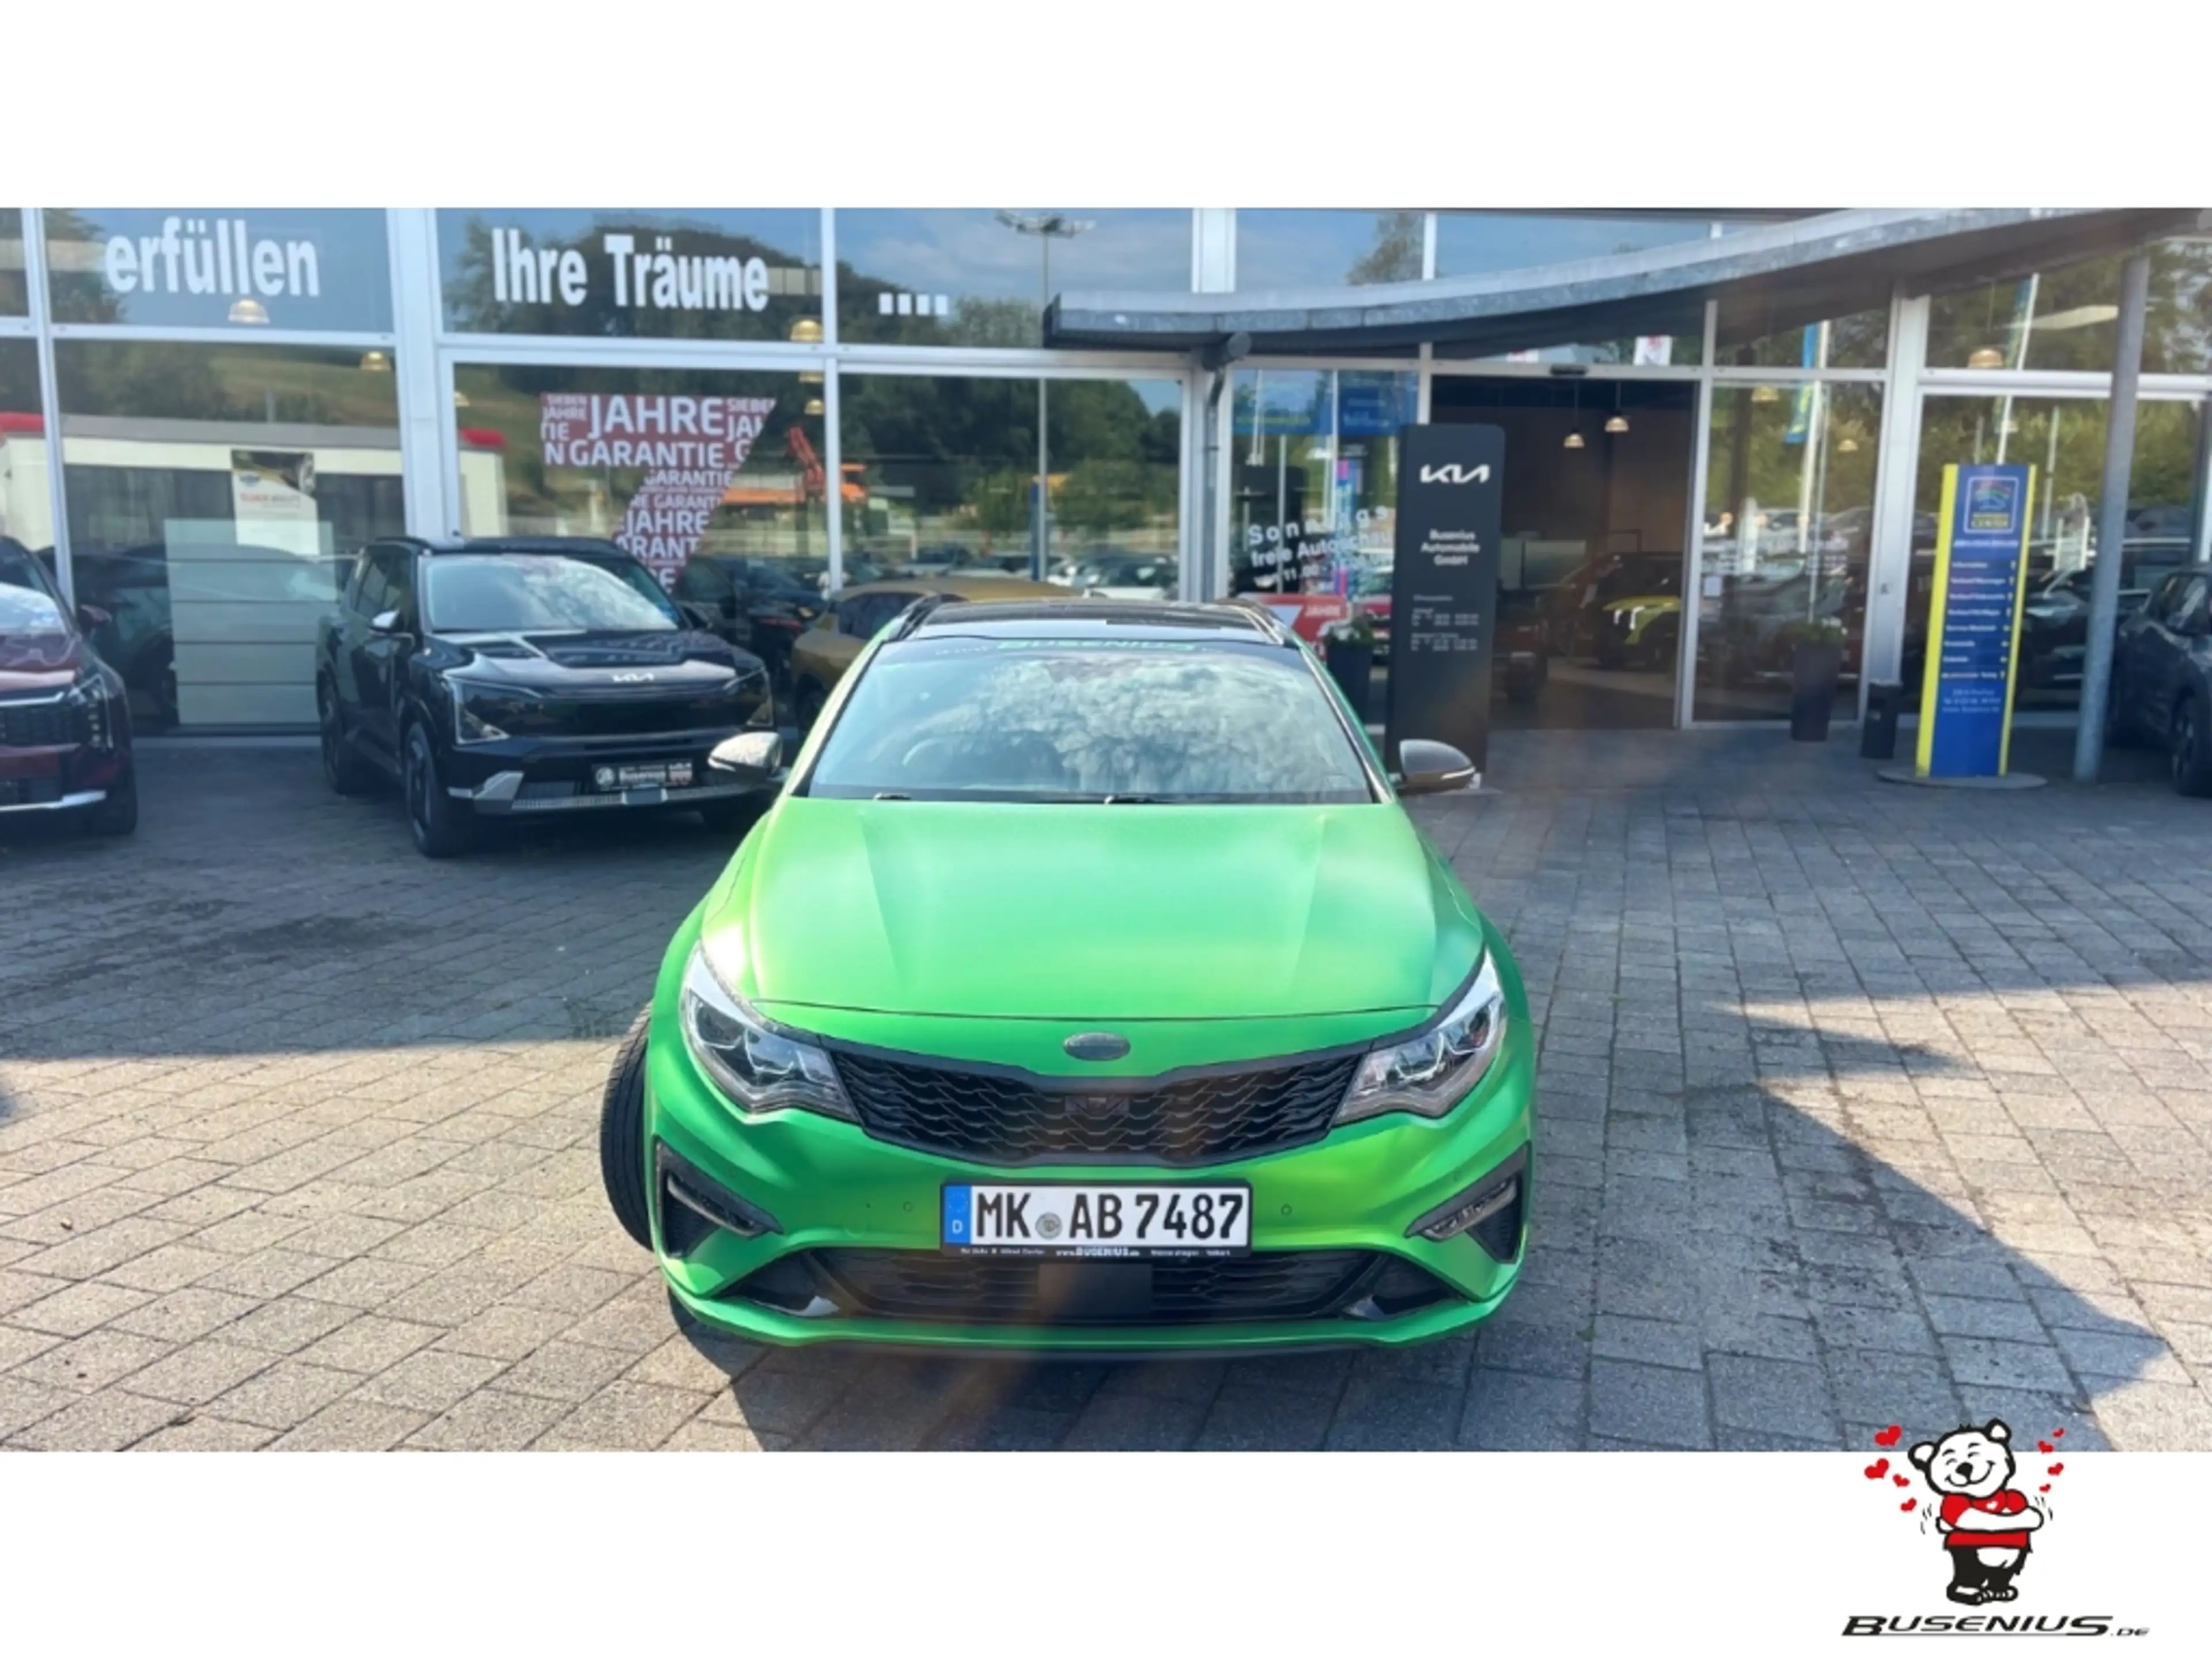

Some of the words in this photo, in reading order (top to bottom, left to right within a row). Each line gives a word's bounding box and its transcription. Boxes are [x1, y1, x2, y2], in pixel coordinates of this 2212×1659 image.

[105, 215, 320, 297] erfüllen
[492, 227, 588, 306] Ihre
[604, 233, 770, 312] Träume
[587, 393, 725, 439] JAHRE
[569, 438, 725, 468] GARANTIE
[1421, 463, 1490, 483] KIA
[624, 509, 710, 538] JAHRE
[952, 1219, 963, 1234] D
[976, 1192, 1032, 1238] MK
[1069, 1193, 1123, 1239] AB
[1135, 1194, 1244, 1240] 7487
